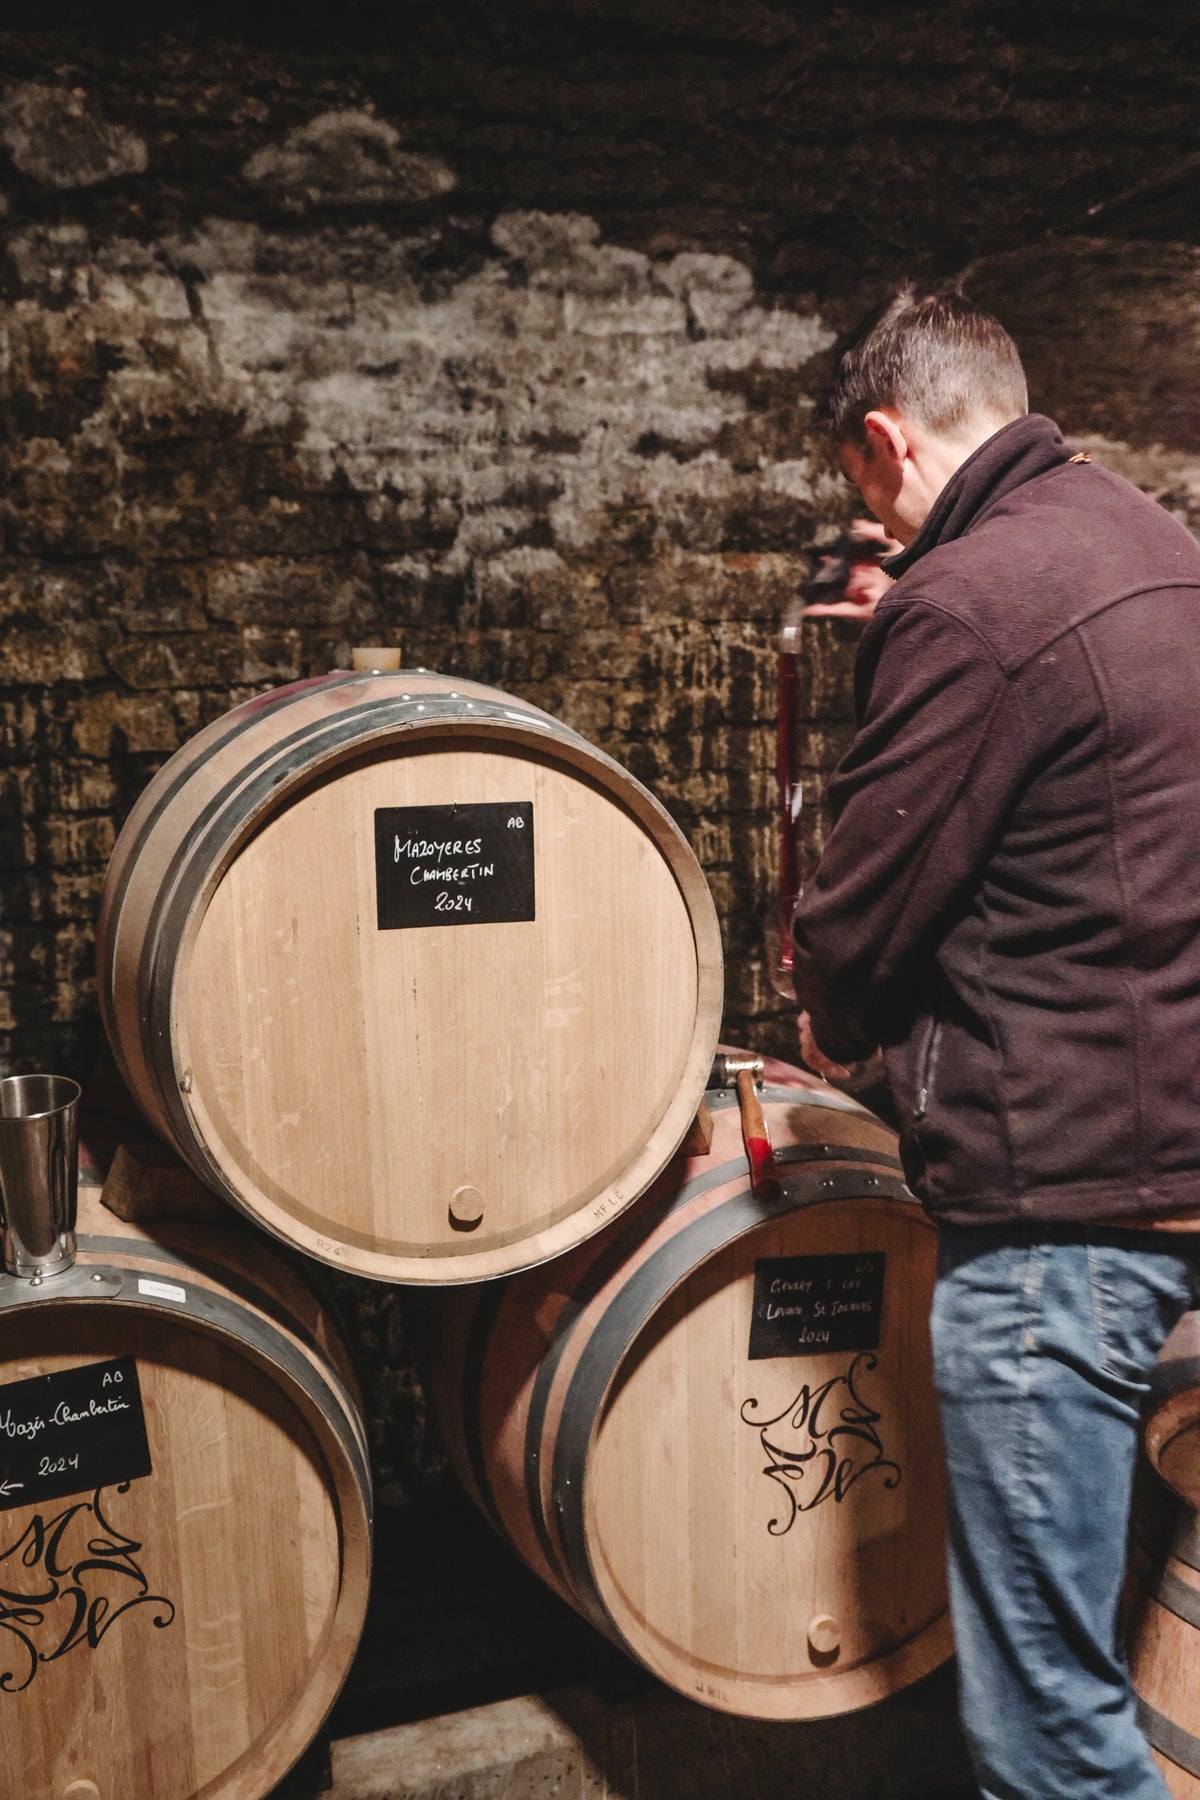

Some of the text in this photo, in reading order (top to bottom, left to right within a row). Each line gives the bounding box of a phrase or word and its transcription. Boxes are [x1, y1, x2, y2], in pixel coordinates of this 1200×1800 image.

[506, 816, 525, 829] AB
[434, 891, 472, 911] 2024
[798, 1326, 830, 1343] 2024
[102, 1370, 124, 1387] AB
[38, 1453, 79, 1476] 2024
